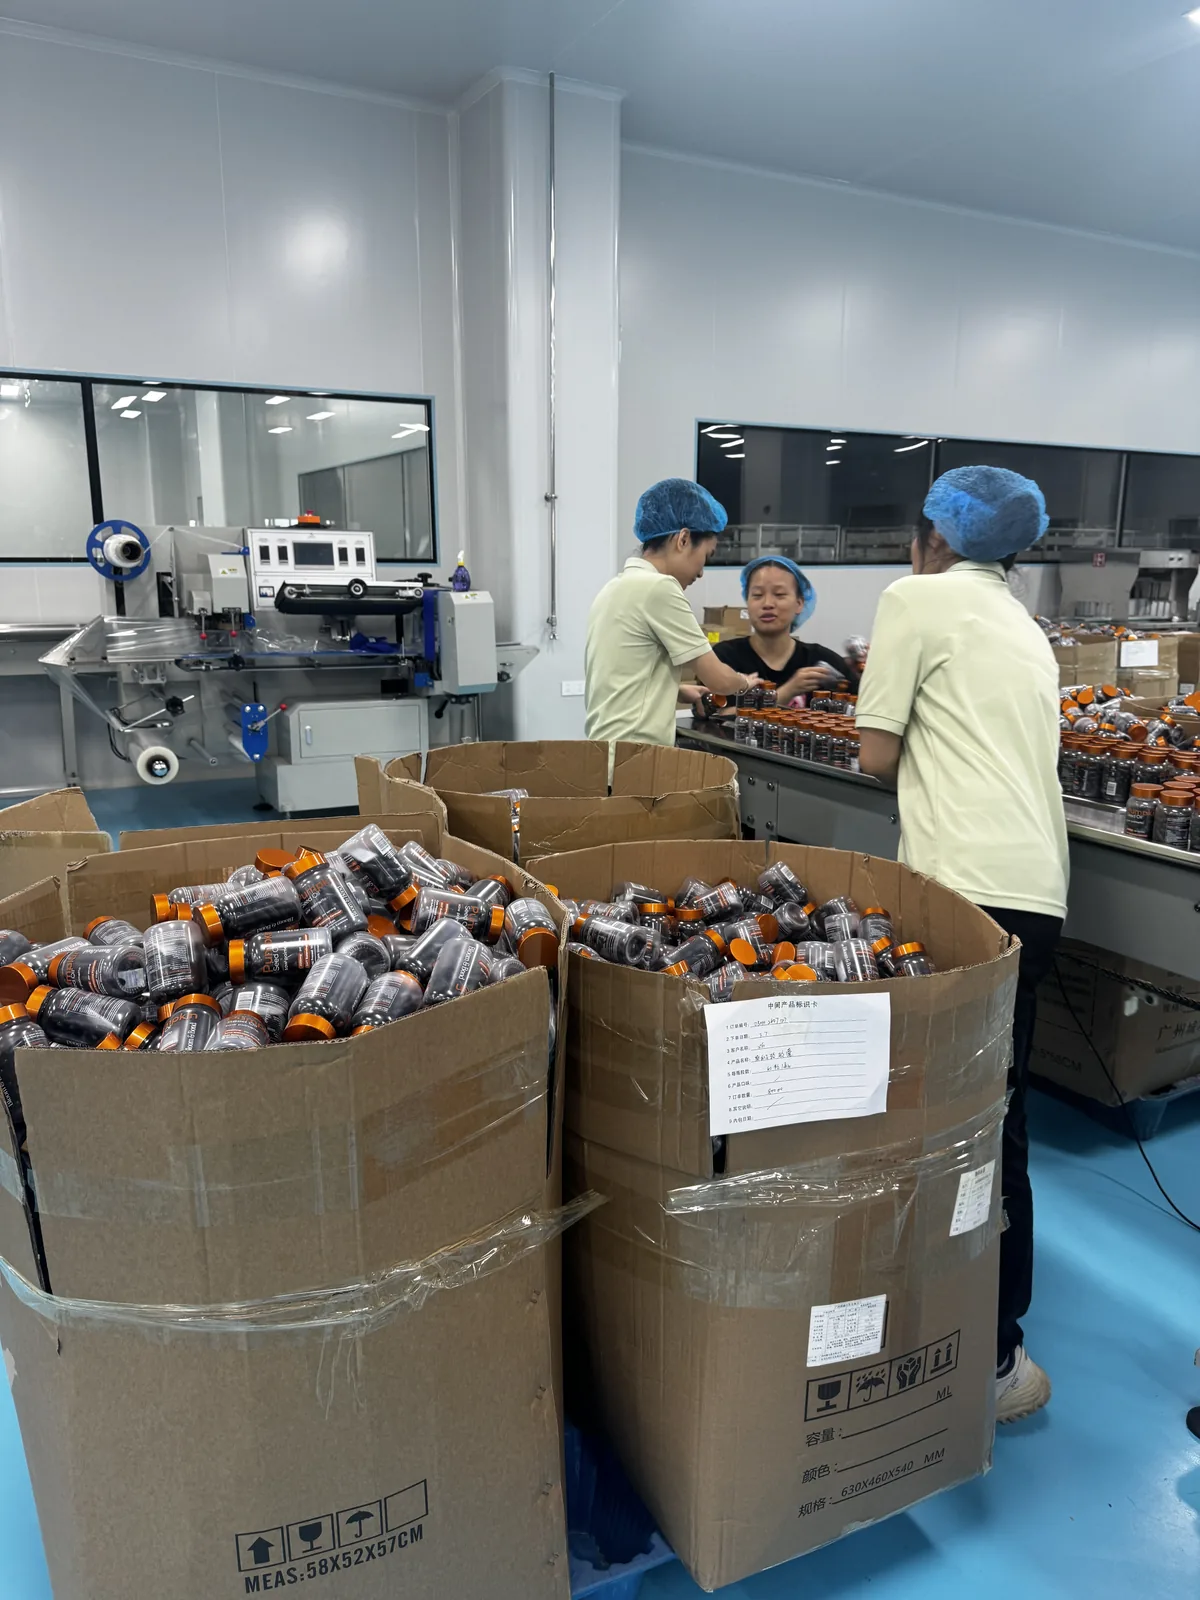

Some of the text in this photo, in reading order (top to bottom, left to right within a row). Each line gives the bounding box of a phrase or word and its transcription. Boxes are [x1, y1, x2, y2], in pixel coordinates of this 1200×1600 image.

[768, 1001, 818, 1010] 中间产品标识卡
[935, 1385, 952, 1400] ML
[841, 1460, 914, 1497] 630X460X540
[923, 1448, 945, 1464] MM
[244, 1524, 424, 1594] MEAS:58X52X57CM
